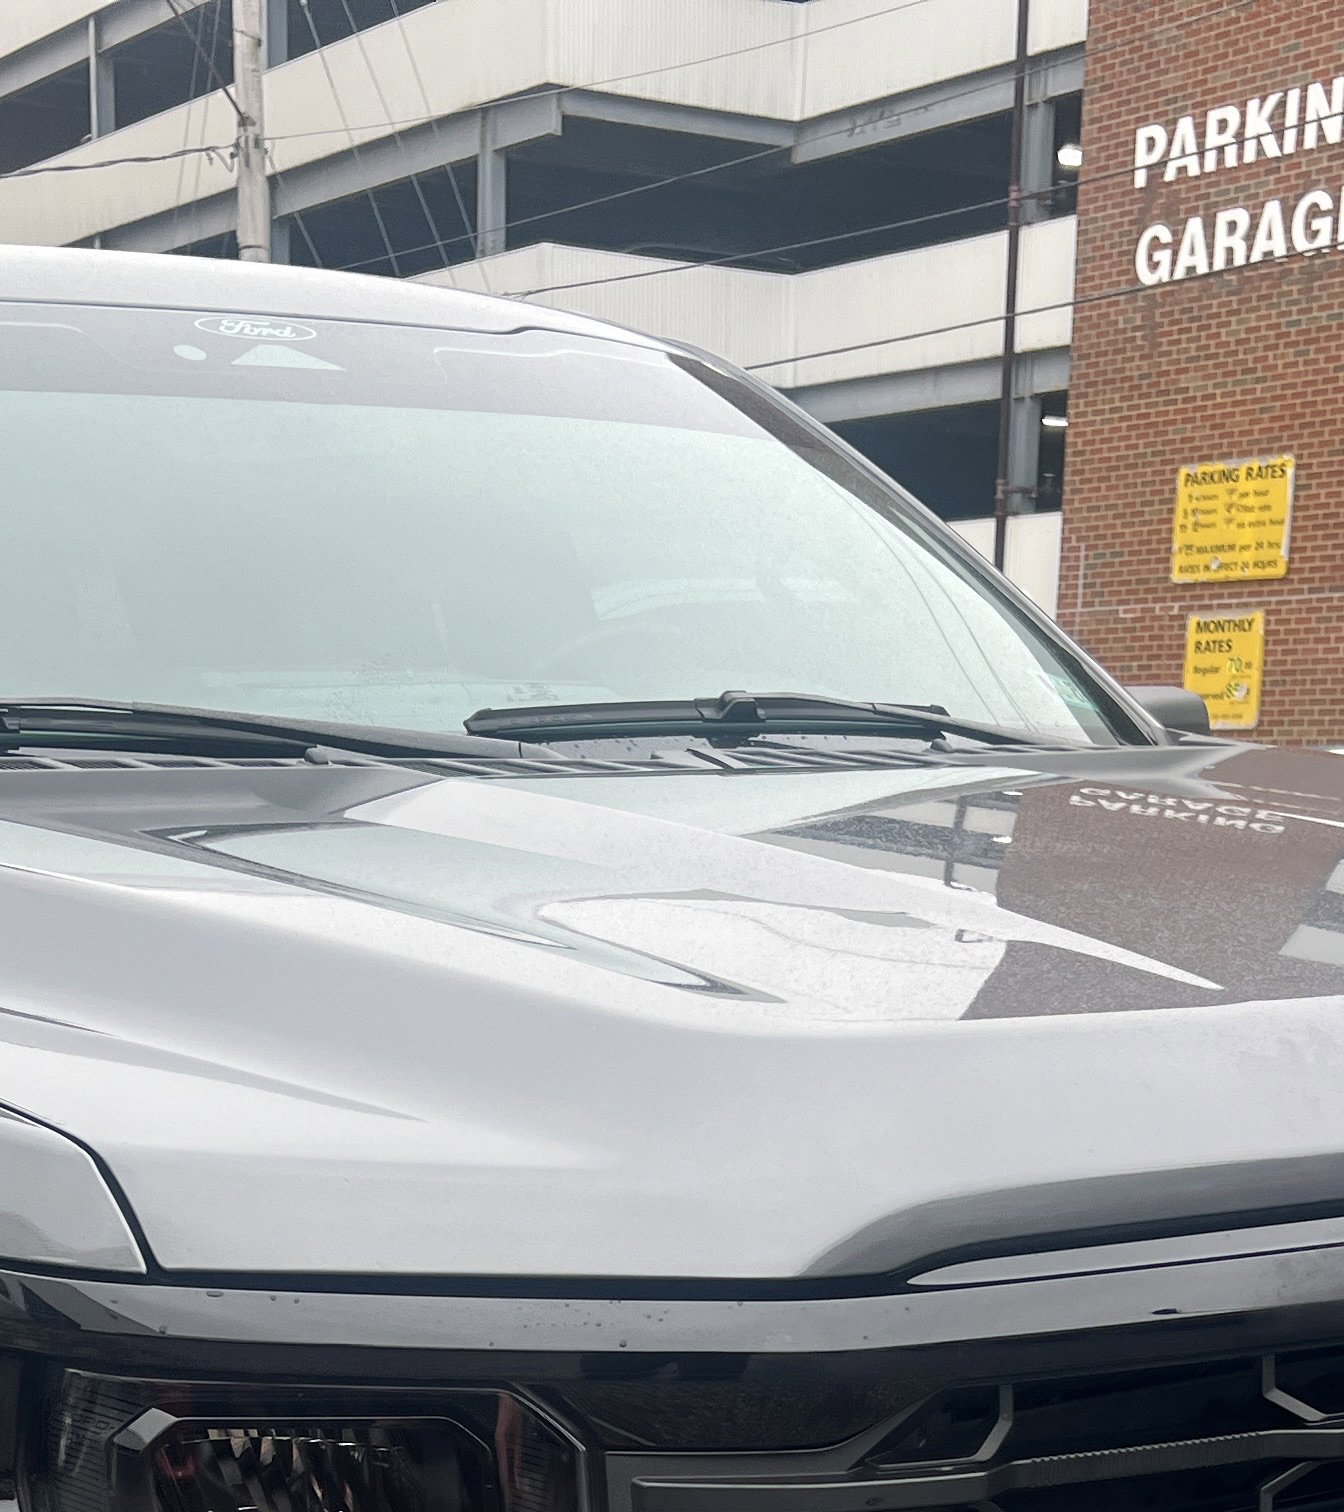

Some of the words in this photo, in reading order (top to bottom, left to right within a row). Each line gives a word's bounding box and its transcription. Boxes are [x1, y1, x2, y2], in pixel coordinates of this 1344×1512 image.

[219, 319, 296, 338] Ford
[1184, 467, 1240, 487] PARKING
[1245, 463, 1287, 481] RATES
[1195, 618, 1254, 634] MONTHLY
[1194, 639, 1233, 654] RATES
